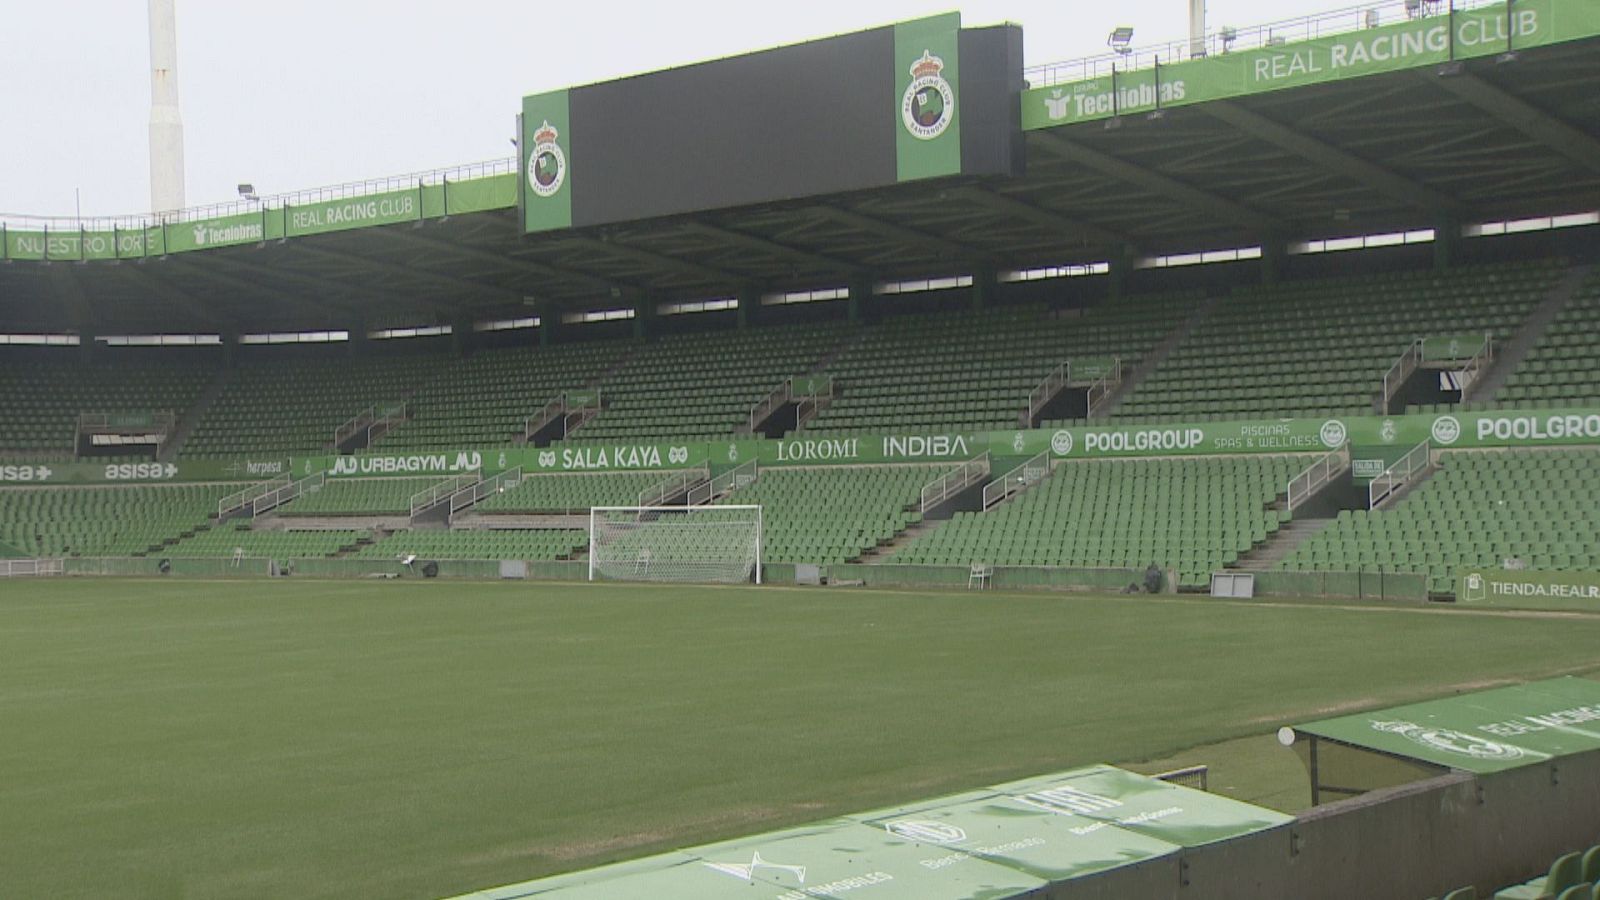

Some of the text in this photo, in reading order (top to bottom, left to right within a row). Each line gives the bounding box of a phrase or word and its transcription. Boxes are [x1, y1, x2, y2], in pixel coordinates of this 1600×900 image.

[1255, 10, 1538, 82] REAL RACING CLUB
[292, 196, 413, 229] REAL RACING CLUB
[17, 236, 105, 254] NUESTRO
[1241, 424, 1290, 436] PISCINAS
[776, 438, 858, 461] LOROMI
[1085, 429, 1204, 452] POOLGROUP
[1214, 437, 1242, 448] SPAS
[1259, 433, 1319, 448] WELLNESS
[361, 455, 446, 472] URBAGYM
[562, 445, 661, 469] SALA KAYA
[105, 463, 166, 479] asisa
[1490, 581, 1600, 599] TIENDA.REALR
